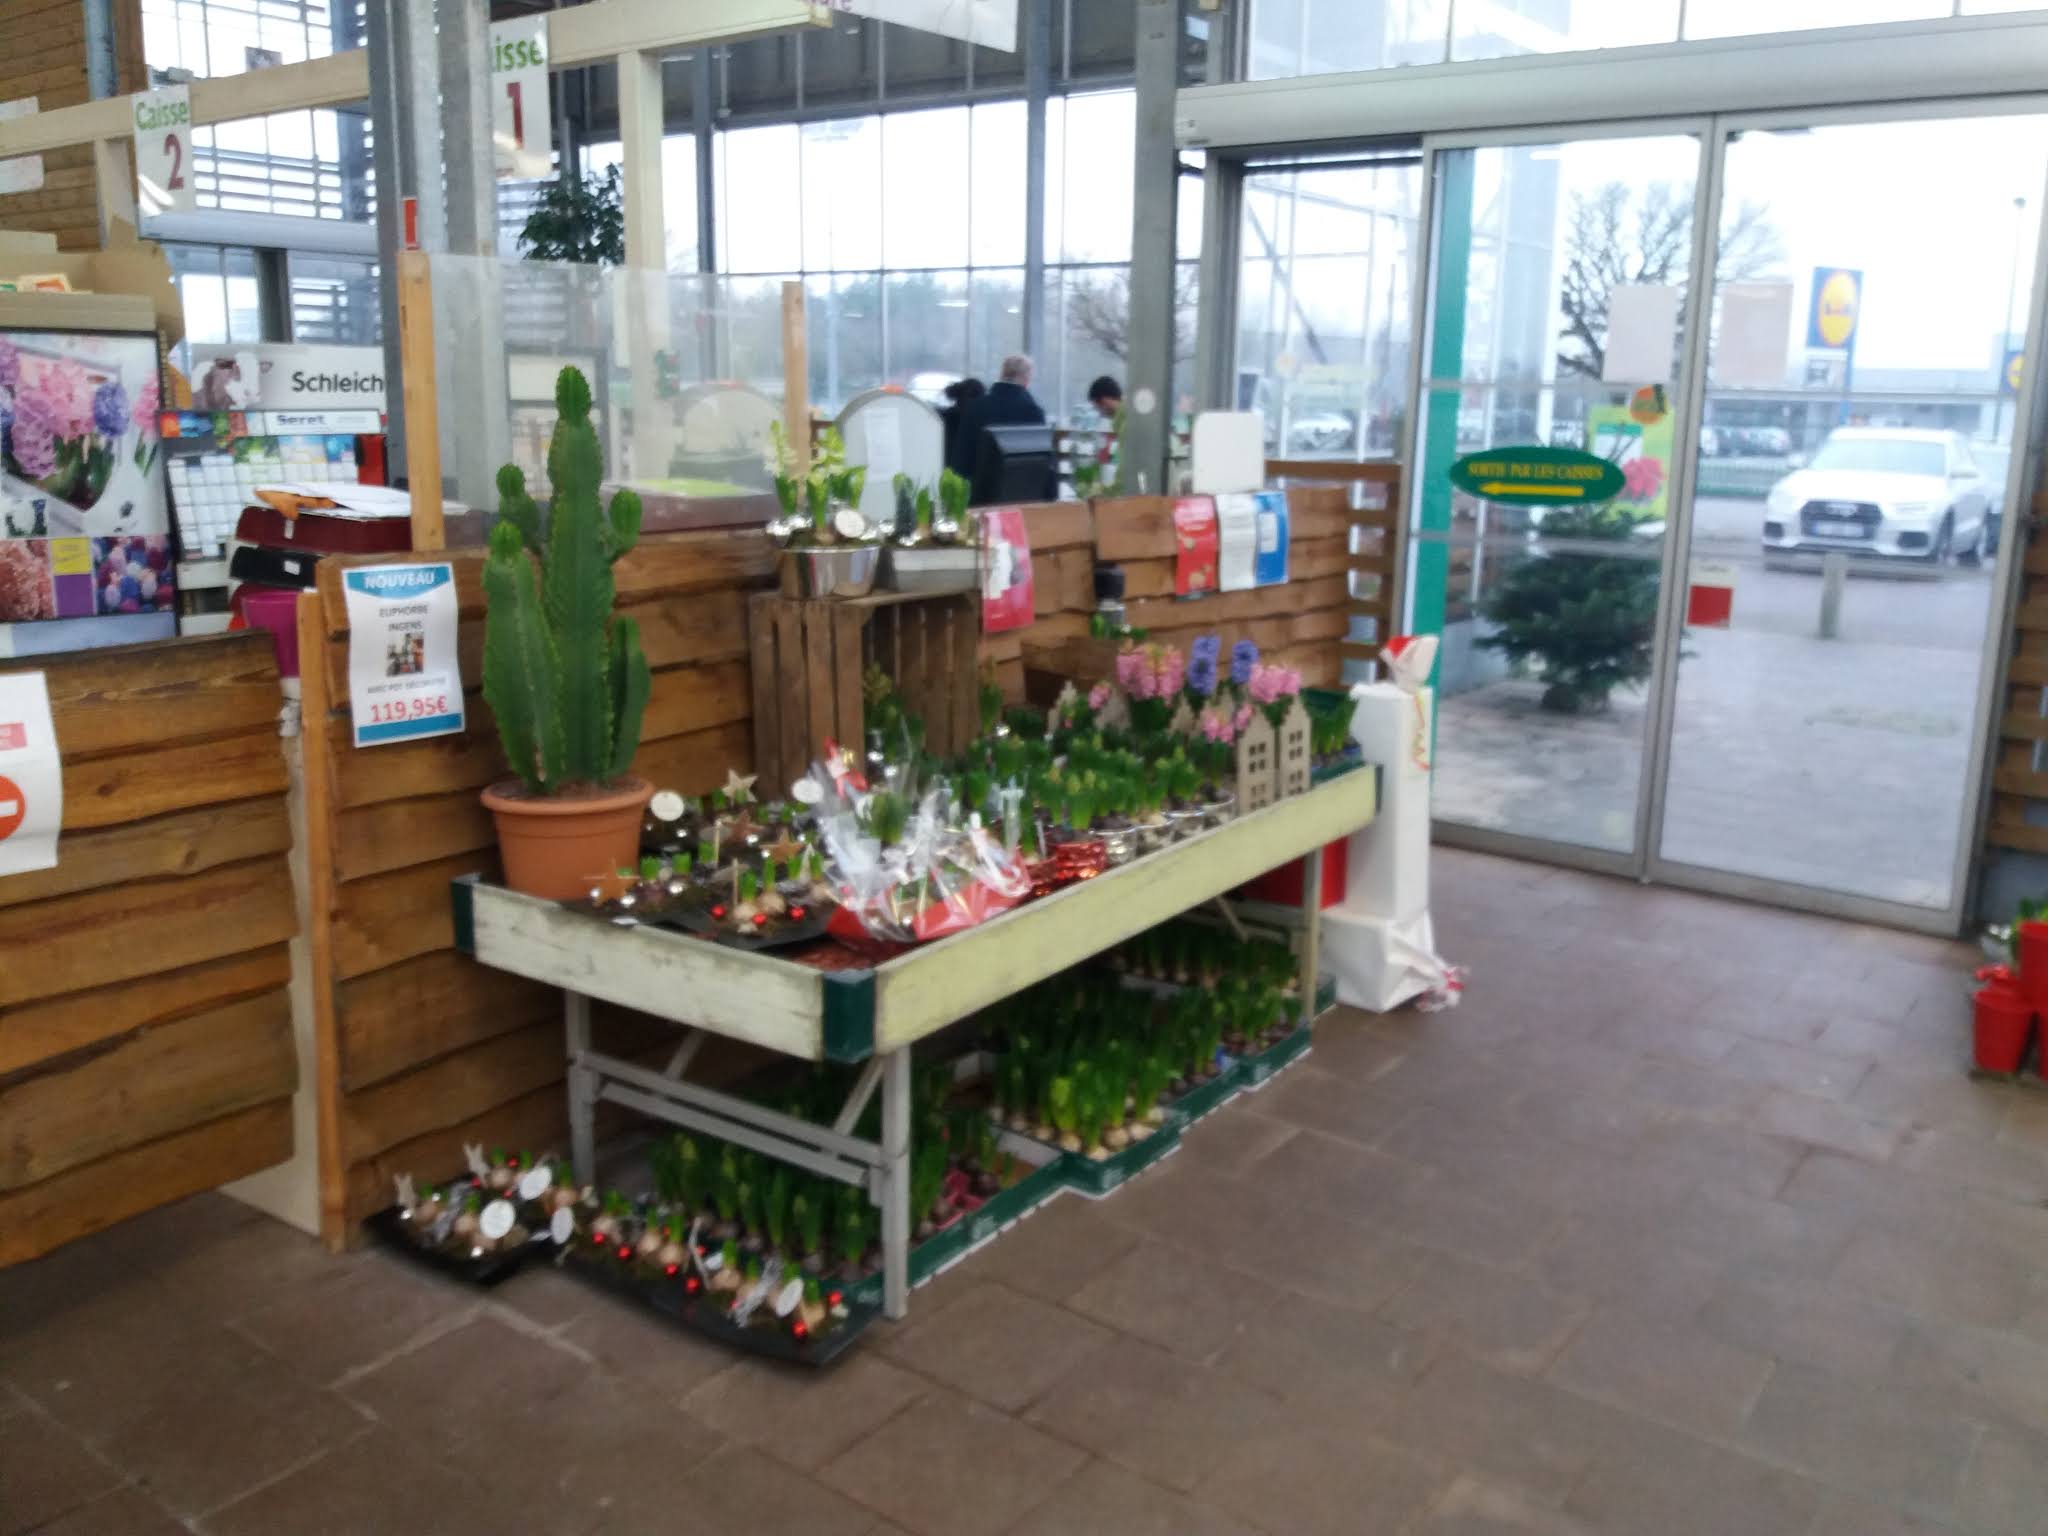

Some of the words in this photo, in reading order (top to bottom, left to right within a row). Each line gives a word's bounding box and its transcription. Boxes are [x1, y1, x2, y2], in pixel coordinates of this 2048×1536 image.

[495, 35, 545, 72] isse
[136, 101, 188, 130] Caisse
[506, 81, 524, 150] 1
[163, 133, 185, 191] 2
[291, 371, 384, 393] Schleich
[363, 571, 435, 589] NOUVEAU
[370, 695, 448, 723] 119,95€
